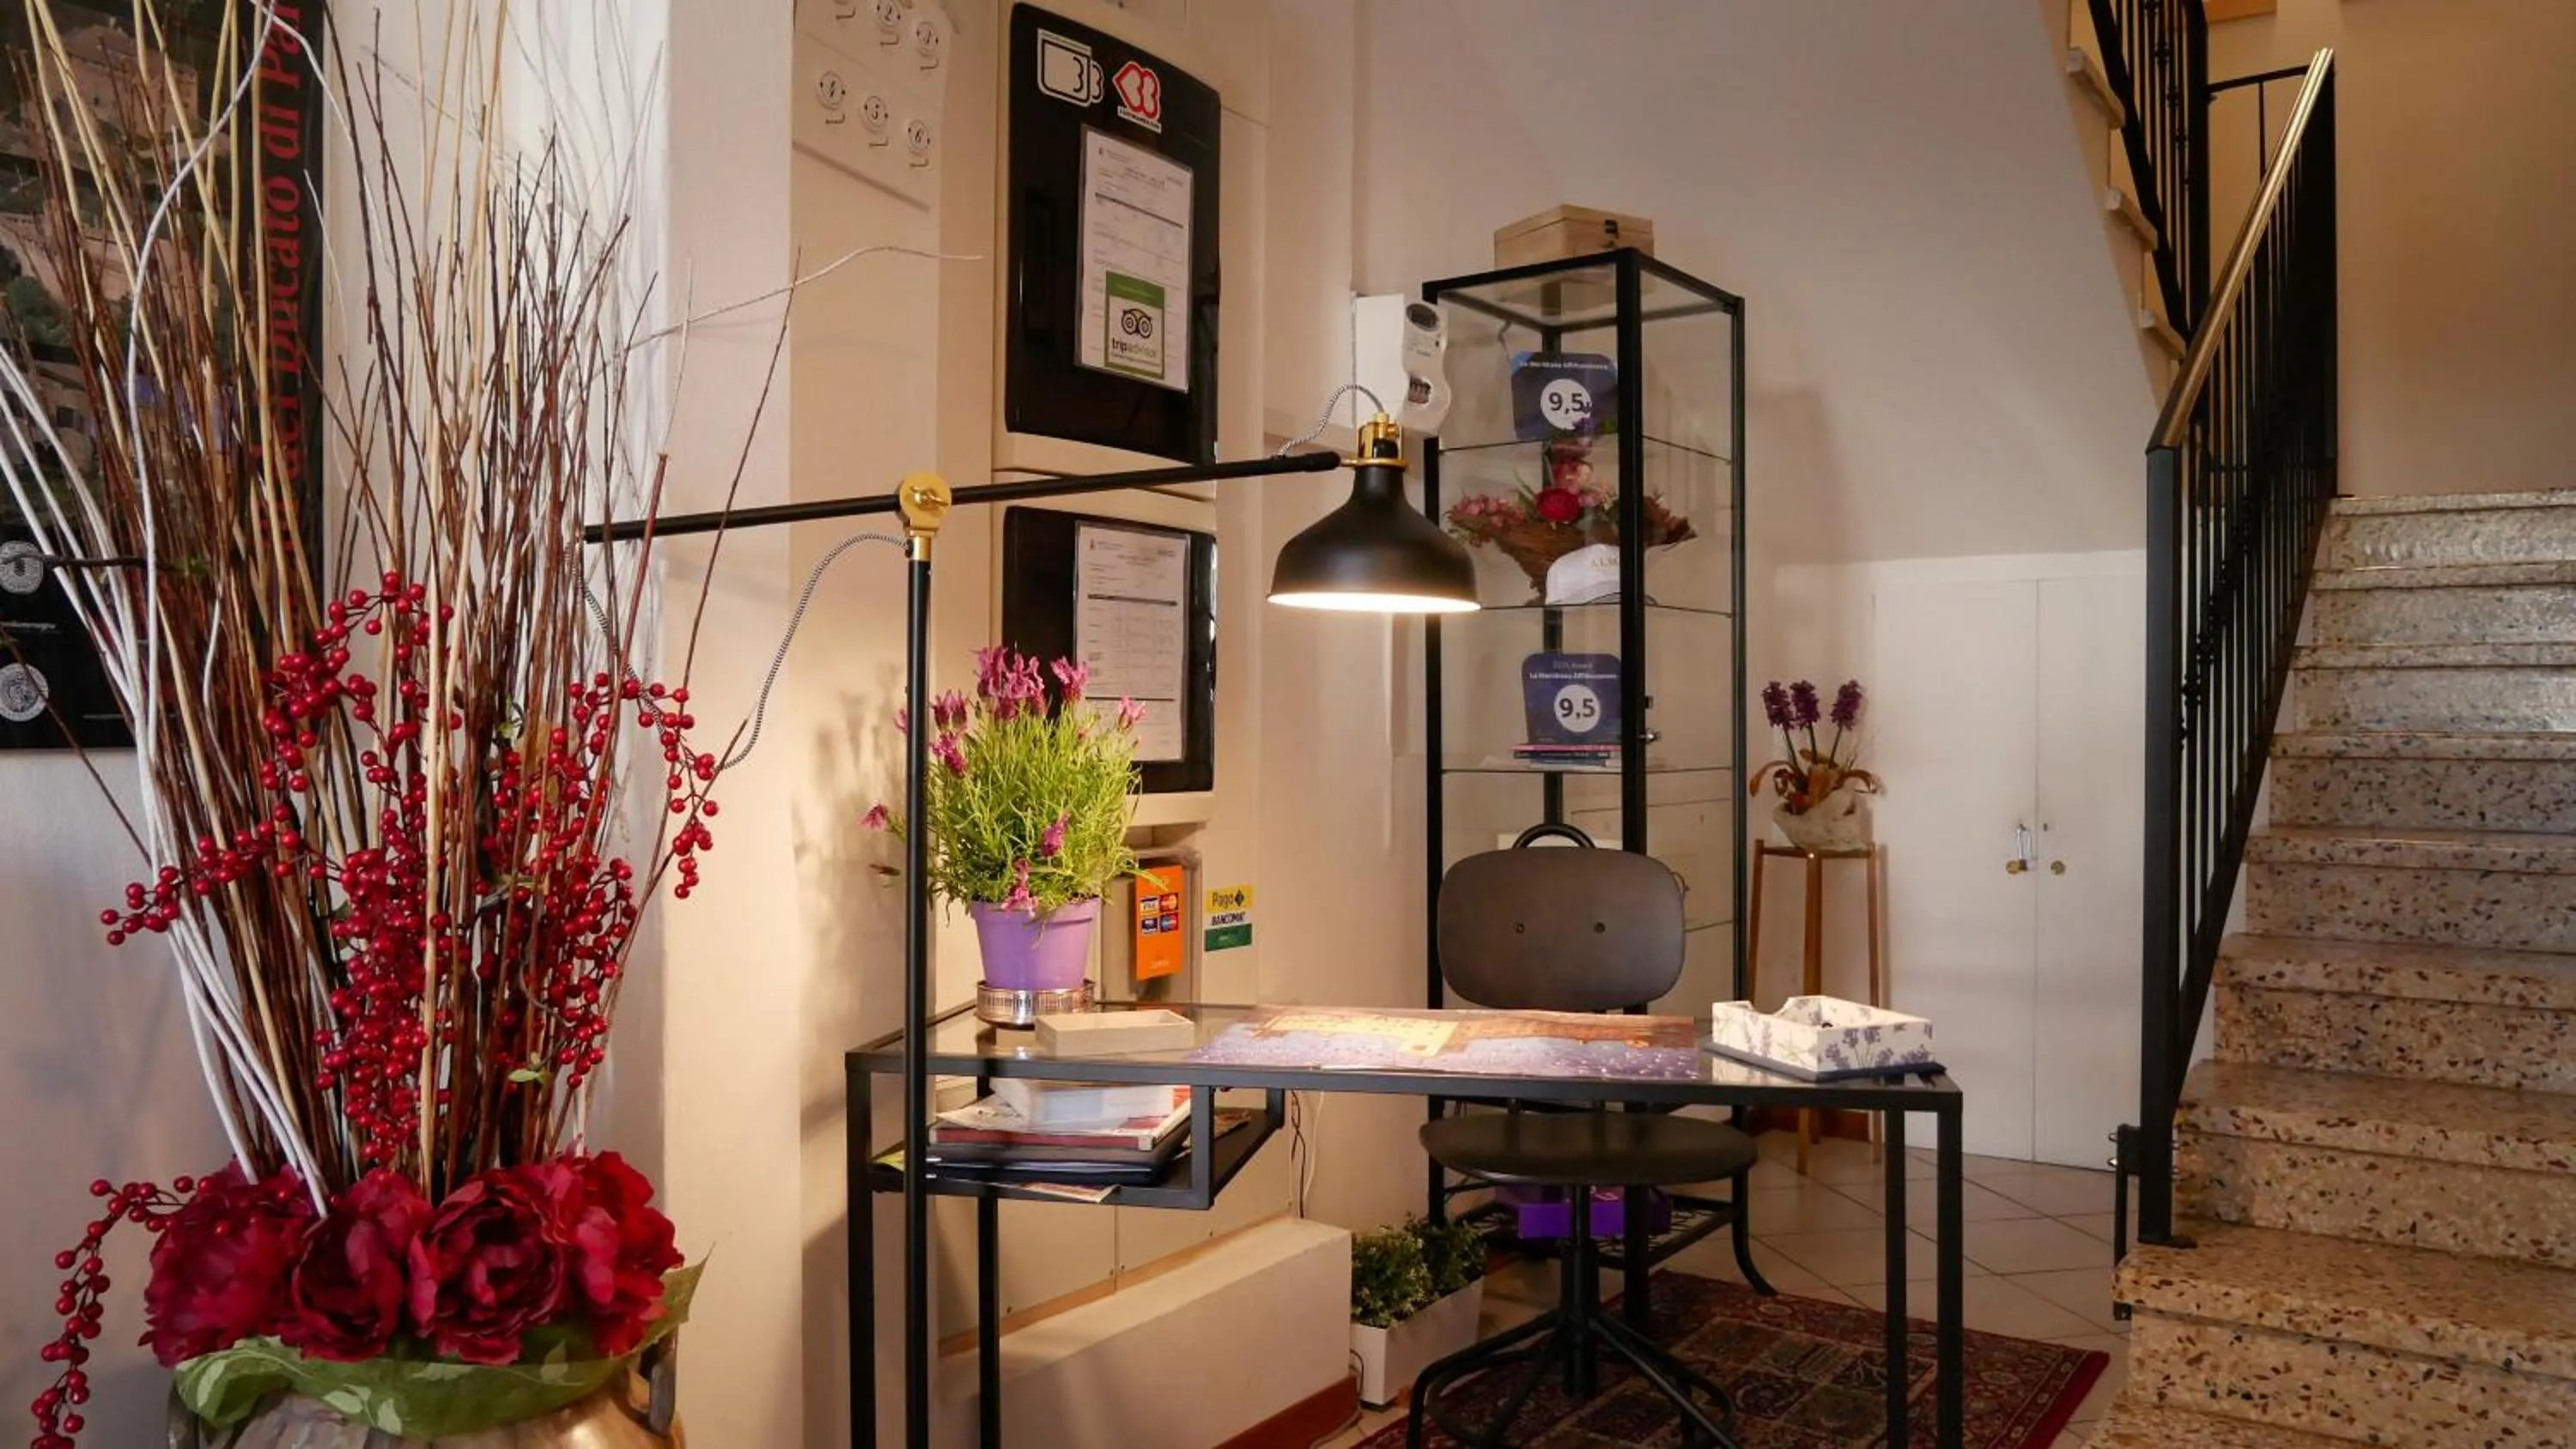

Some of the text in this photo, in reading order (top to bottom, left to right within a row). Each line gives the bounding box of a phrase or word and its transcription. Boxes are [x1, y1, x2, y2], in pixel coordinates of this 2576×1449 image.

[255, 101, 302, 160] di
[1548, 391, 1585, 415] 9,5
[1558, 698, 1595, 719] 9,5
